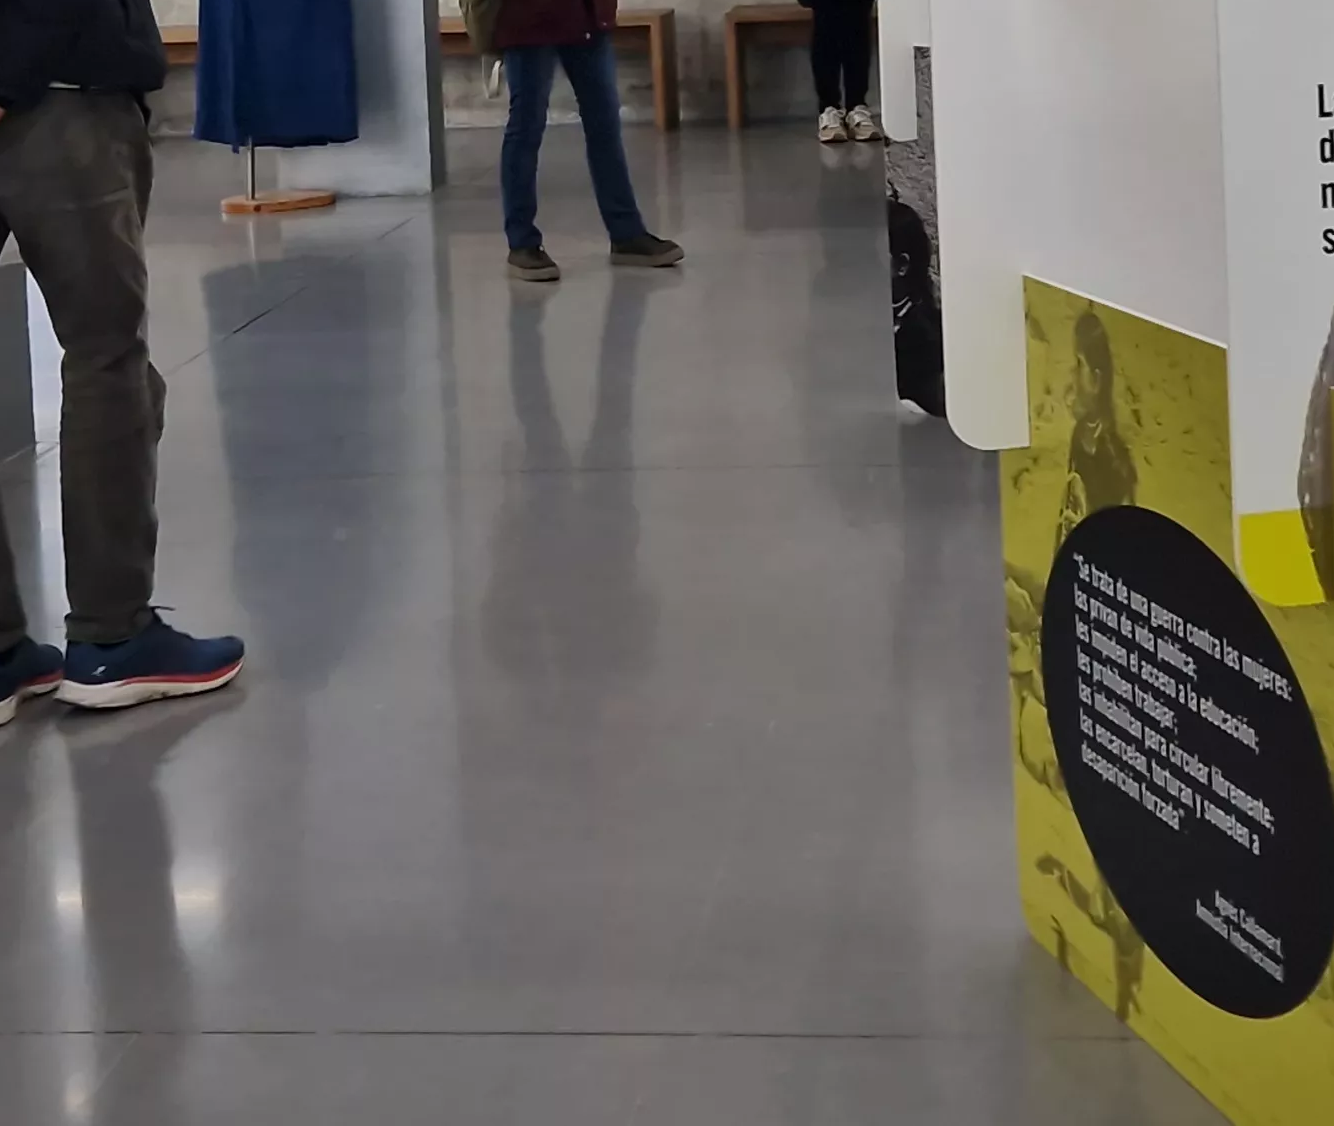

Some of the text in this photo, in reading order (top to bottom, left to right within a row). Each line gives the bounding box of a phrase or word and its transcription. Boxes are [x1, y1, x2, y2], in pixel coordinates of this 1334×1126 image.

[1074, 582, 1088, 612] las
[1120, 611, 1133, 639] de
[1091, 563, 1114, 597] trata
[1116, 577, 1129, 605] de
[1150, 601, 1184, 638] guerra
[1186, 623, 1221, 660] contra
[1223, 637, 1240, 671] las
[1075, 613, 1089, 643] les
[1129, 650, 1138, 674] el
[1141, 660, 1176, 698] acceso
[1178, 683, 1185, 705] a
[1187, 682, 1197, 712] la
[1076, 644, 1091, 674] les
[1078, 676, 1092, 706] las
[1080, 706, 1094, 737] las
[1251, 833, 1260, 855] a
